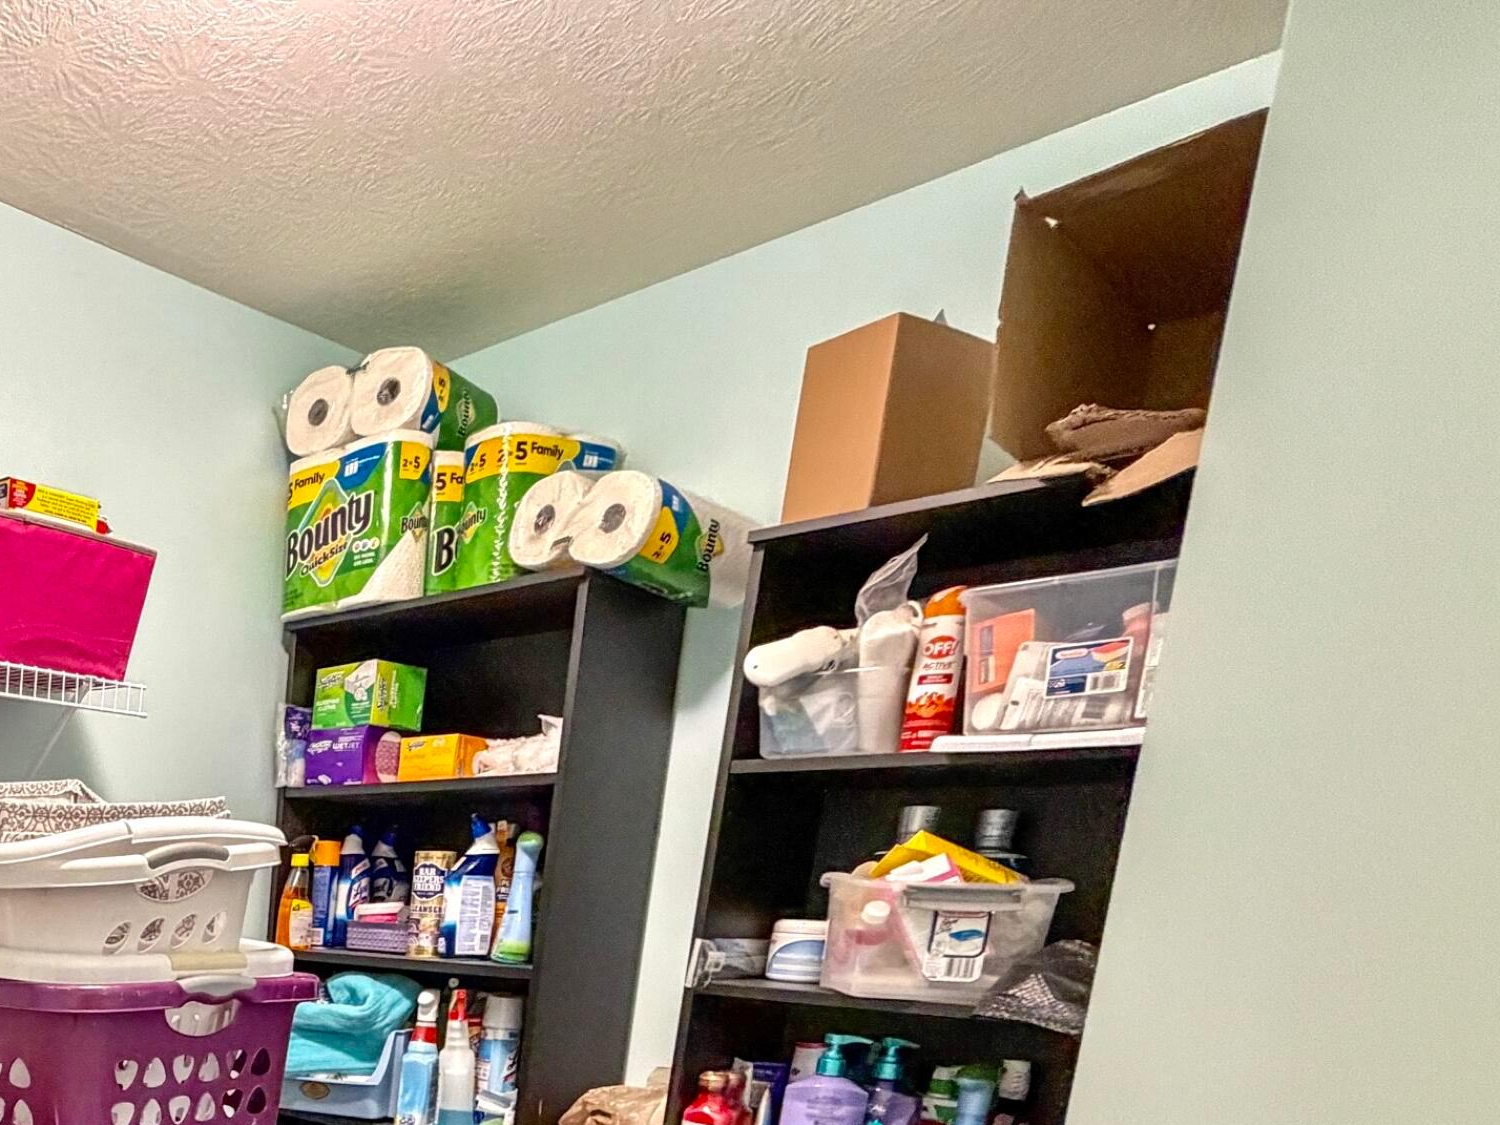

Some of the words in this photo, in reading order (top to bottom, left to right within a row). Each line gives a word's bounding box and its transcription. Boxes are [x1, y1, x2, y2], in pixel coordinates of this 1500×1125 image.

[531, 442, 564, 460] Family
[294, 472, 325, 489] Family
[287, 493, 372, 578] Bounty
[300, 543, 347, 576] QuickSize
